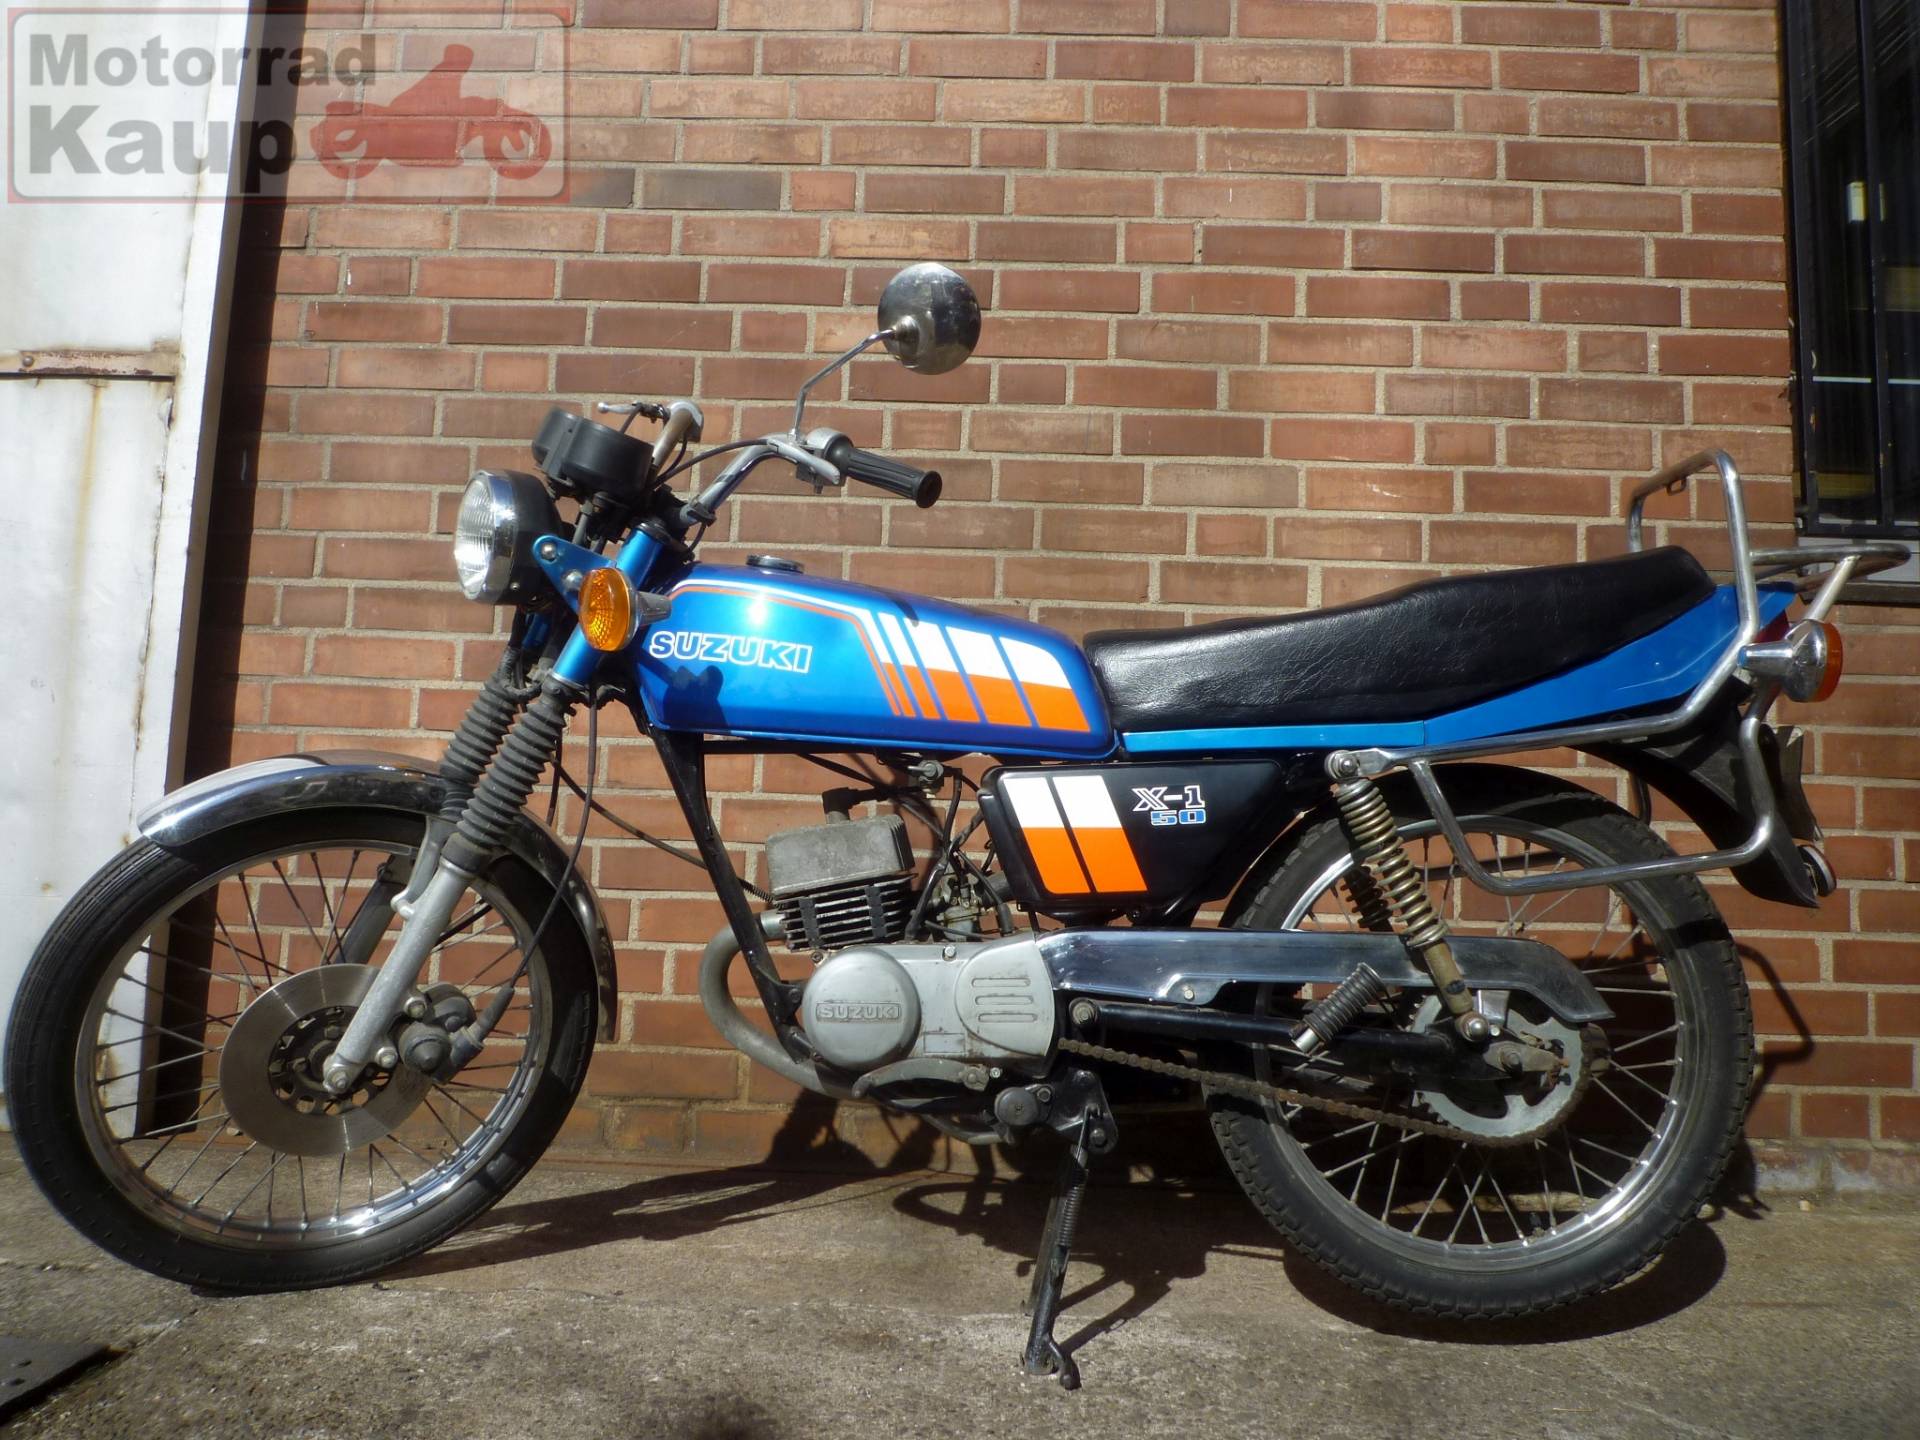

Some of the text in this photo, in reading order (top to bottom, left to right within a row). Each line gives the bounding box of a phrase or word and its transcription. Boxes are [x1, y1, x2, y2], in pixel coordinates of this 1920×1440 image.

[649, 631, 812, 673] SUZUKI
[1131, 785, 1205, 811] X-1
[1150, 808, 1206, 826] 50
[818, 1004, 899, 1020] SUZUKI
